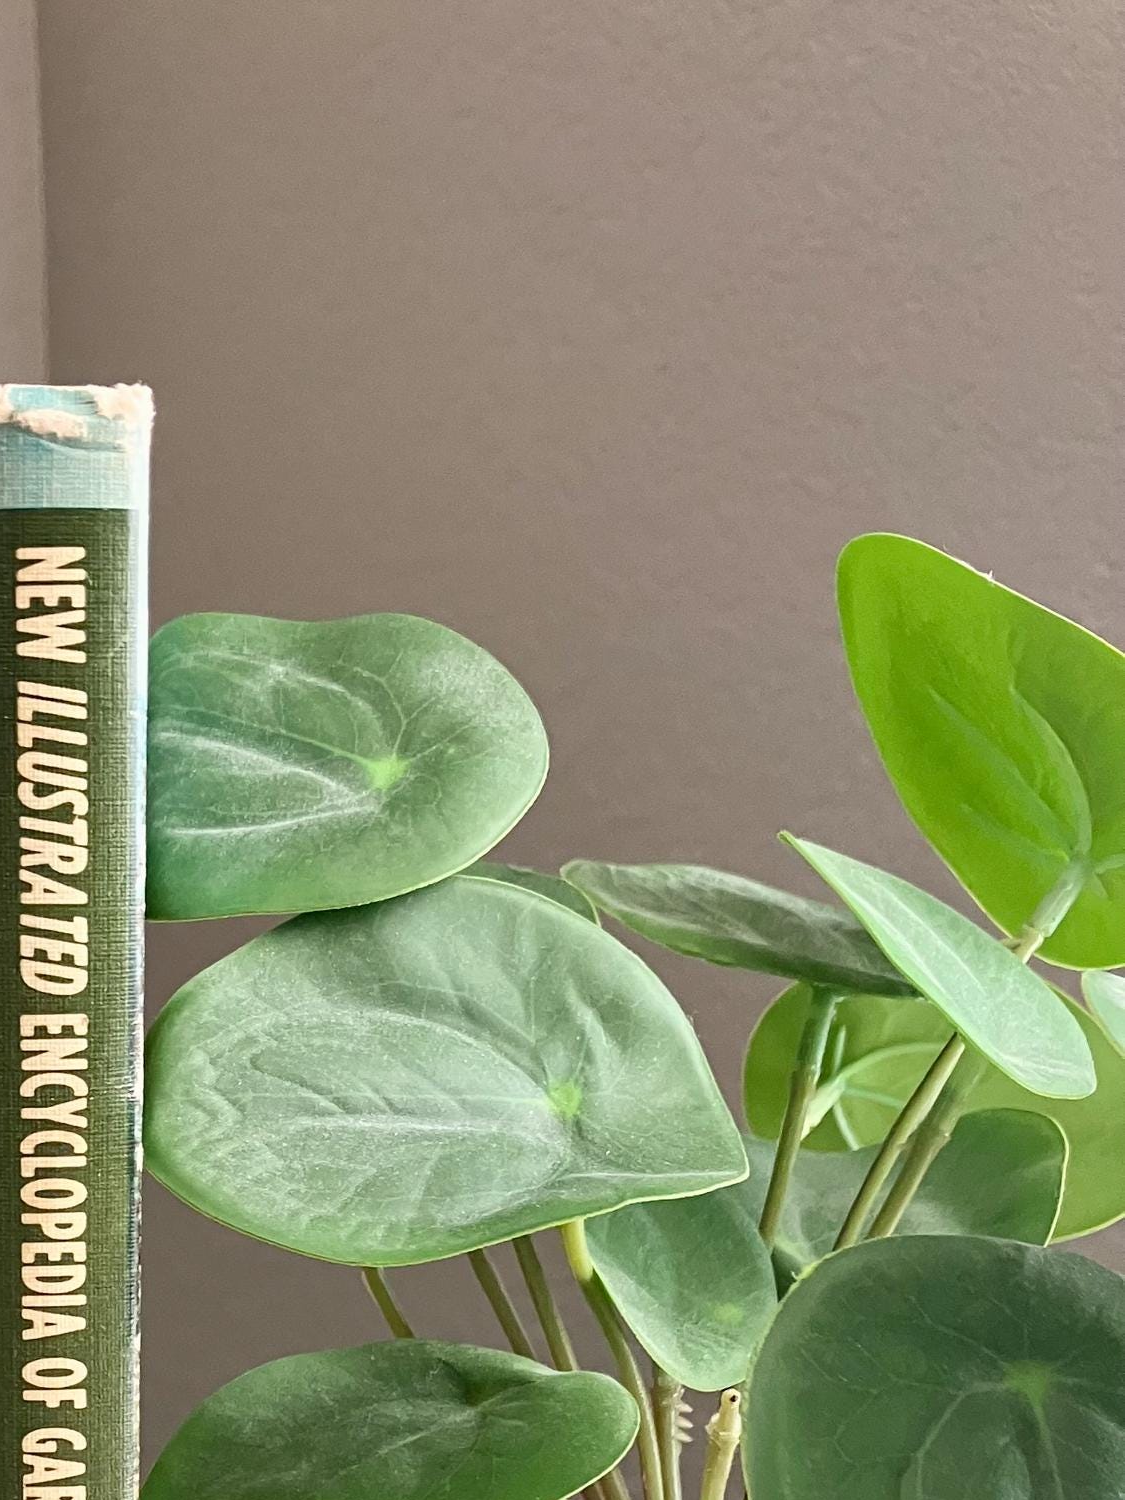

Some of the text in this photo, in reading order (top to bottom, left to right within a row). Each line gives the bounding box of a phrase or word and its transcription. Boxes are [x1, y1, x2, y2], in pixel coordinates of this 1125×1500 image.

[15, 546, 87, 664] NEW
[16, 680, 88, 996] ILLUSTRATED
[19, 1013, 88, 1341] ENCYCLOPEDIA
[21, 1357, 88, 1410] OF
